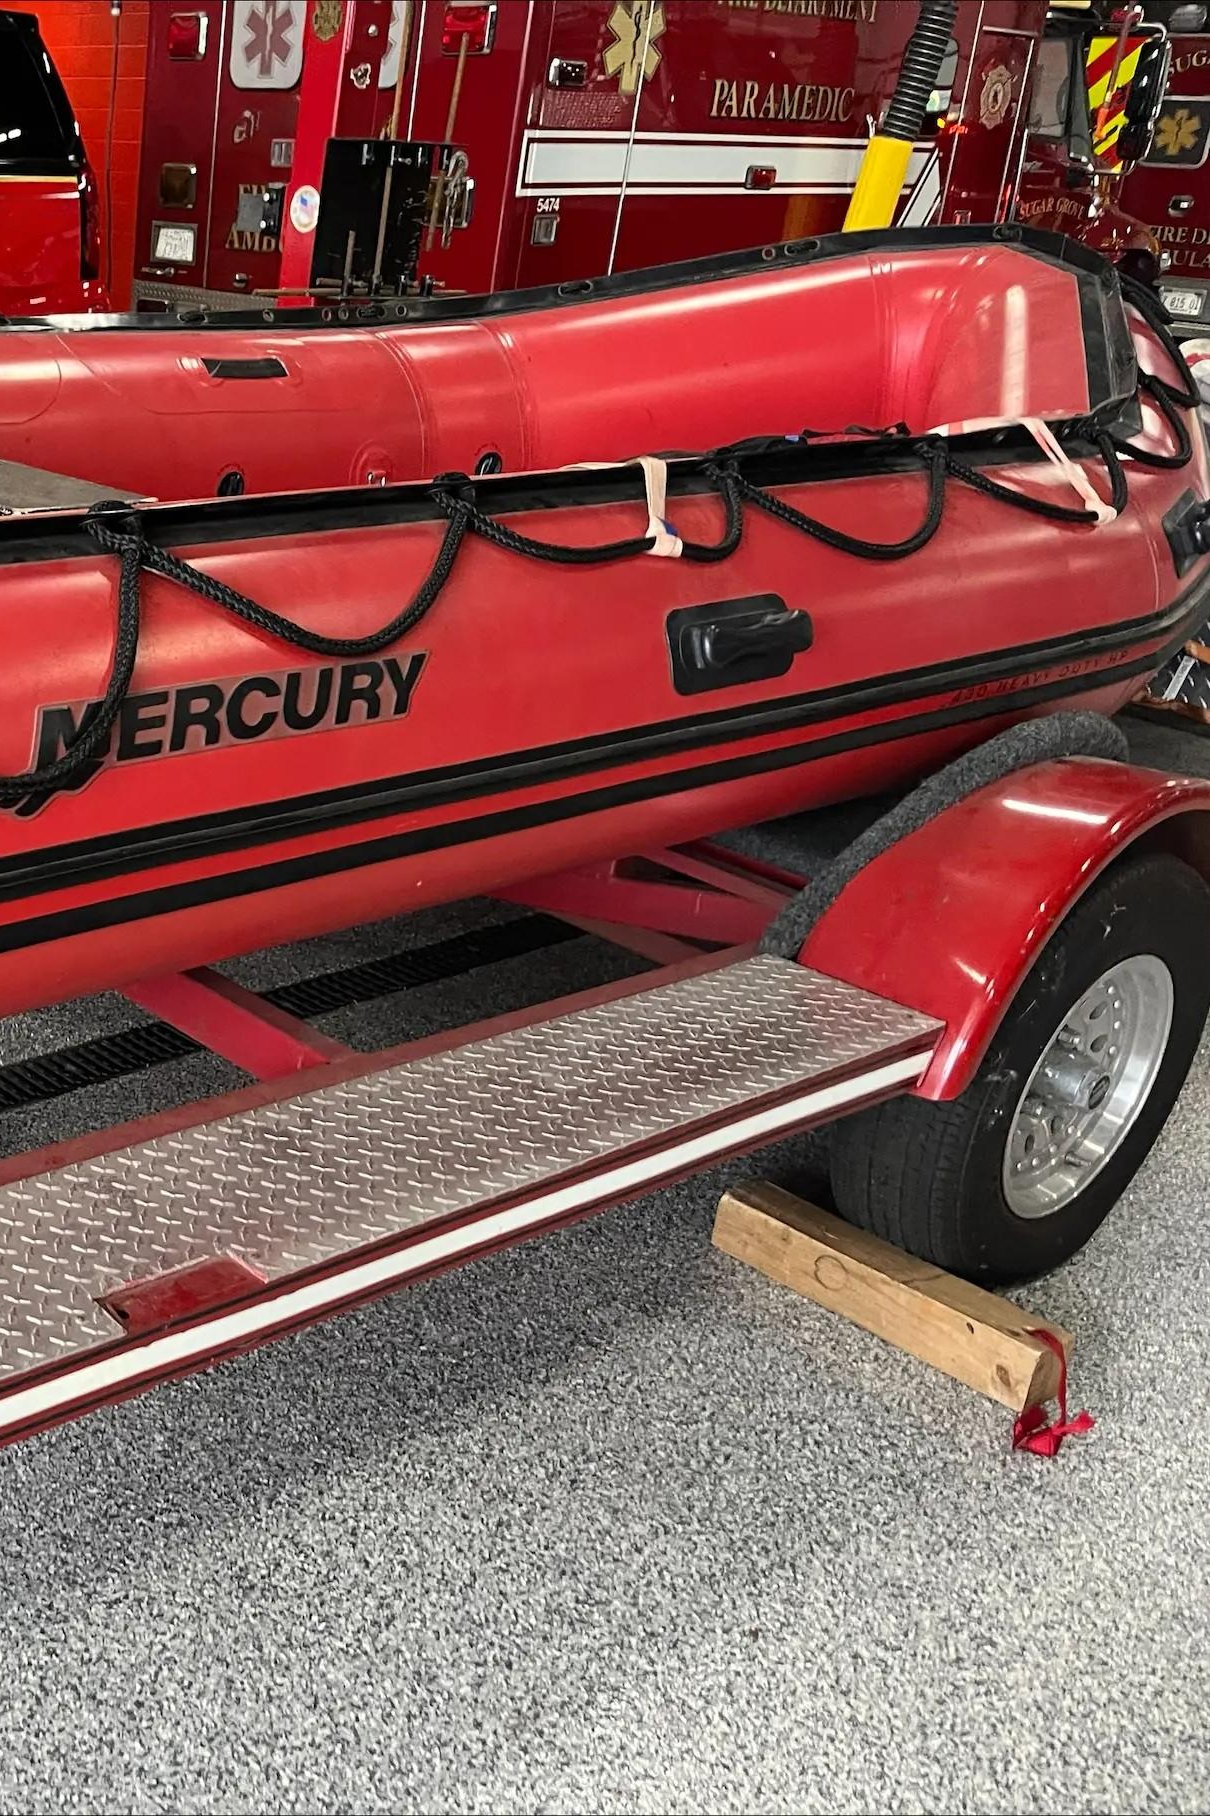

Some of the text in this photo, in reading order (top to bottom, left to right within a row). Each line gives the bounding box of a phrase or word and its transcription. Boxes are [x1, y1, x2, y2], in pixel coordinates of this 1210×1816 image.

[710, 79, 855, 122] PARAMEDIC
[536, 197, 560, 212] 5474
[1019, 197, 1055, 220] SUGAR
[30, 652, 427, 776] MERCURY
